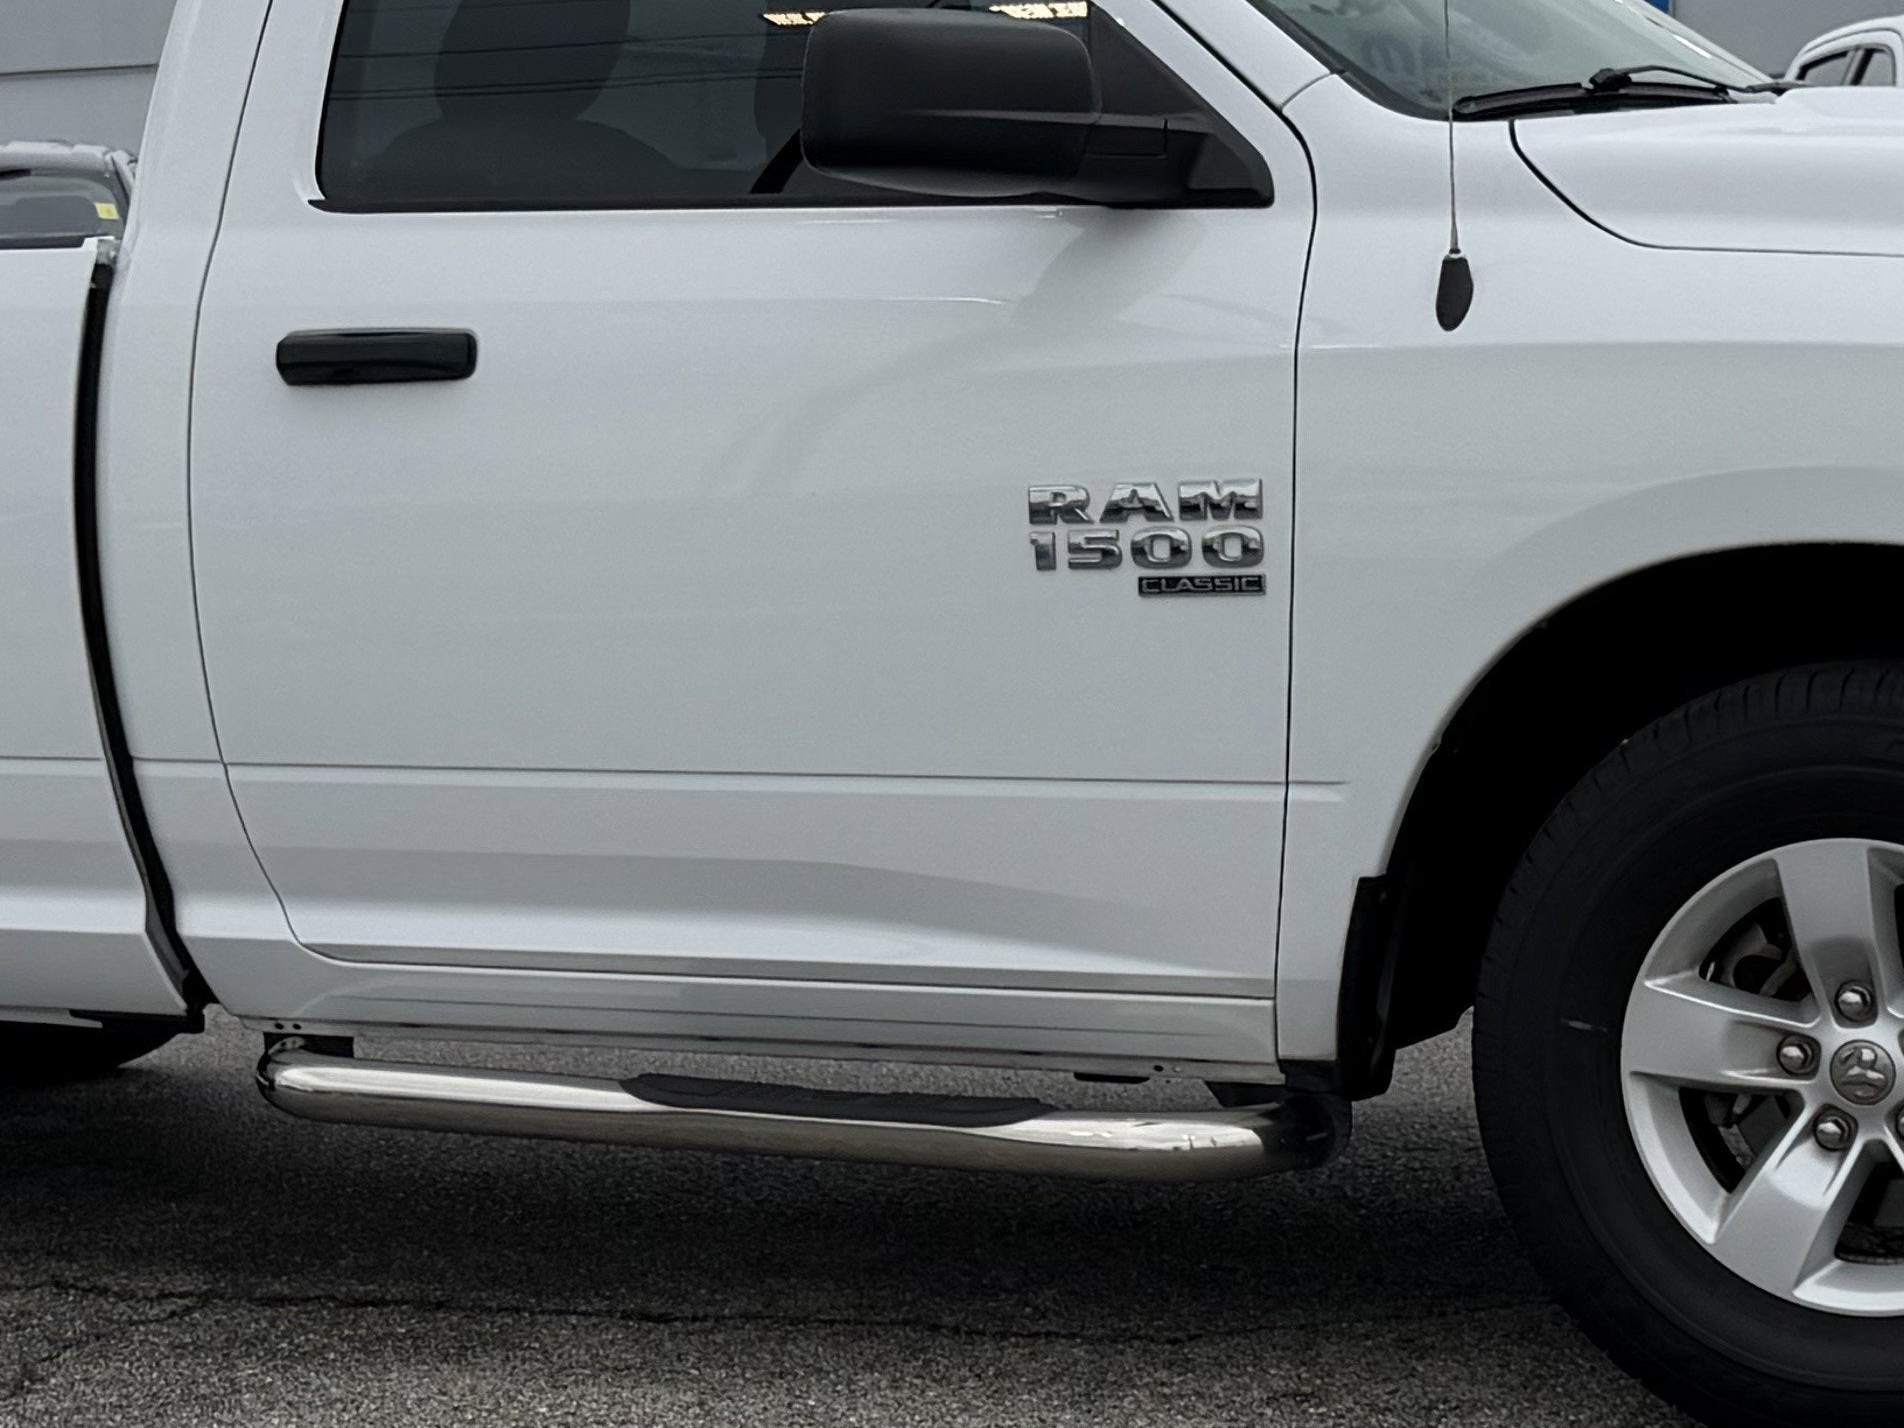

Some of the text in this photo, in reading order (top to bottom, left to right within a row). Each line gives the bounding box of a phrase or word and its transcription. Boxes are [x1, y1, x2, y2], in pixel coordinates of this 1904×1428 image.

[1028, 478, 1263, 524] RAM
[1029, 525, 1264, 571] 1500
[1140, 575, 1261, 594] CLASSIC
